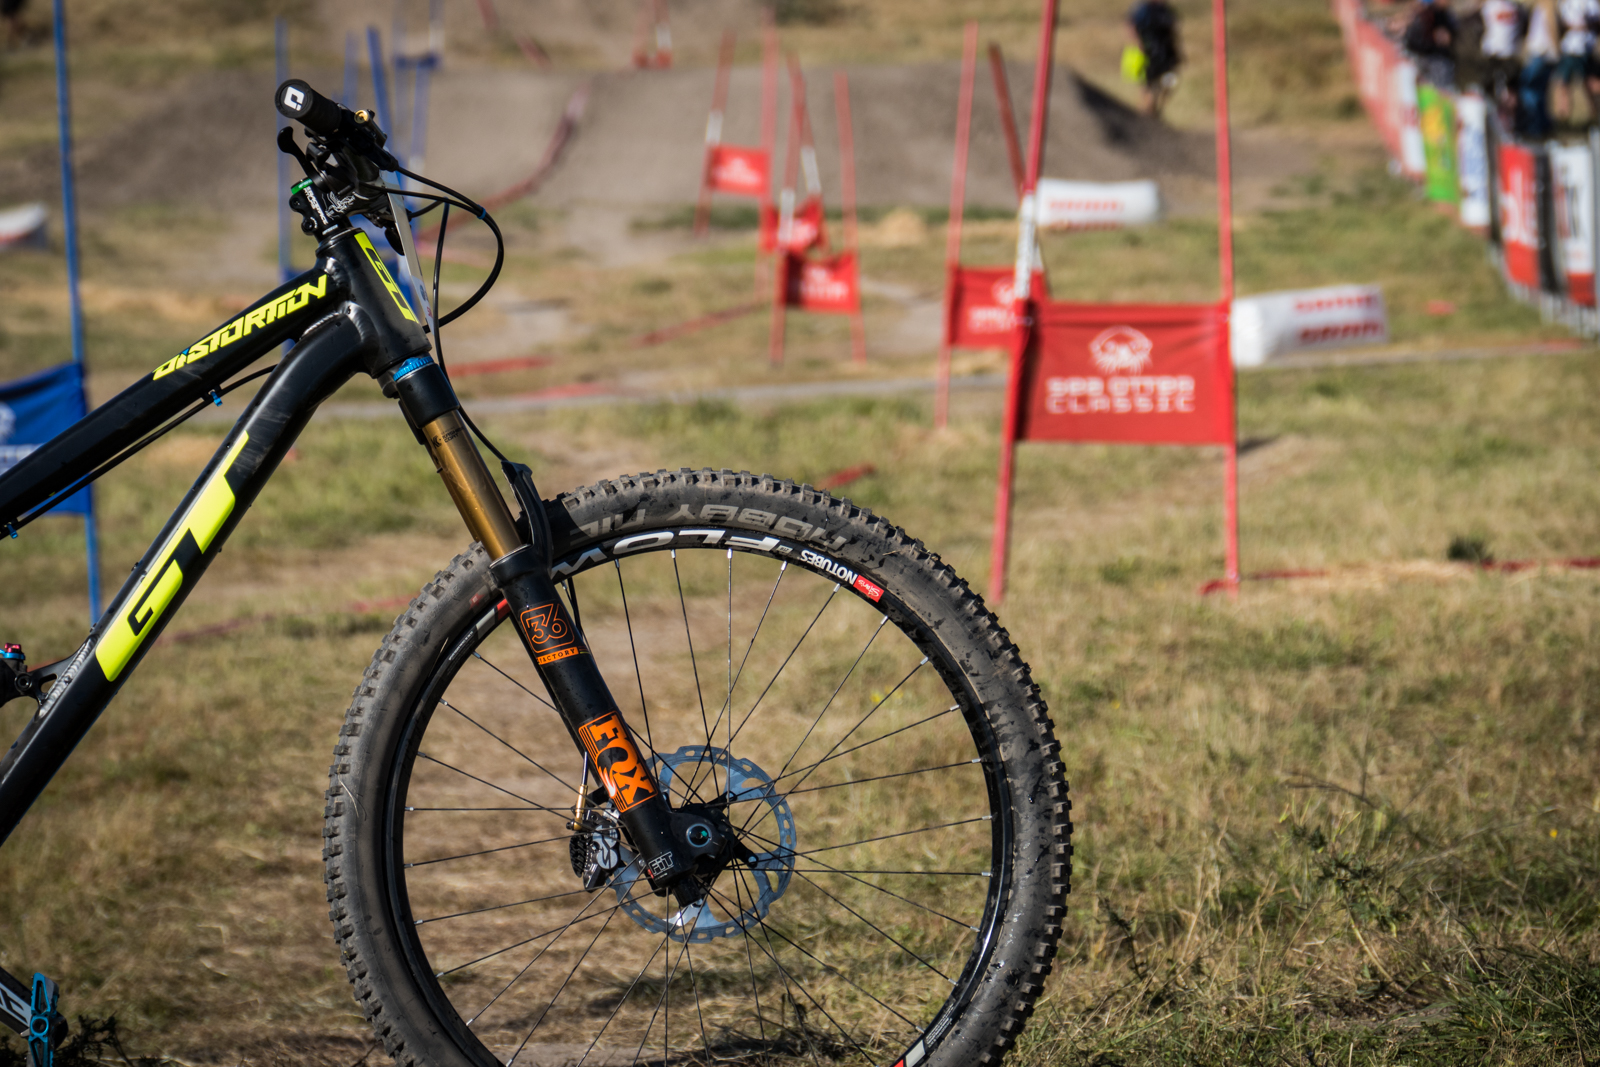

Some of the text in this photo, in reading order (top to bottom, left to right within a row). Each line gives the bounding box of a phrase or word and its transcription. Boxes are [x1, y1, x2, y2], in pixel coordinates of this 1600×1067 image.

[152, 273, 328, 381] DISTORTION
[1046, 395, 1196, 414] CLASSIC
[667, 503, 848, 551] NOBBY
[95, 429, 250, 682] GT
[551, 529, 781, 580] FLOW
[801, 549, 859, 585] NOTUBES
[525, 603, 569, 645] 36
[588, 714, 655, 806] FOX
